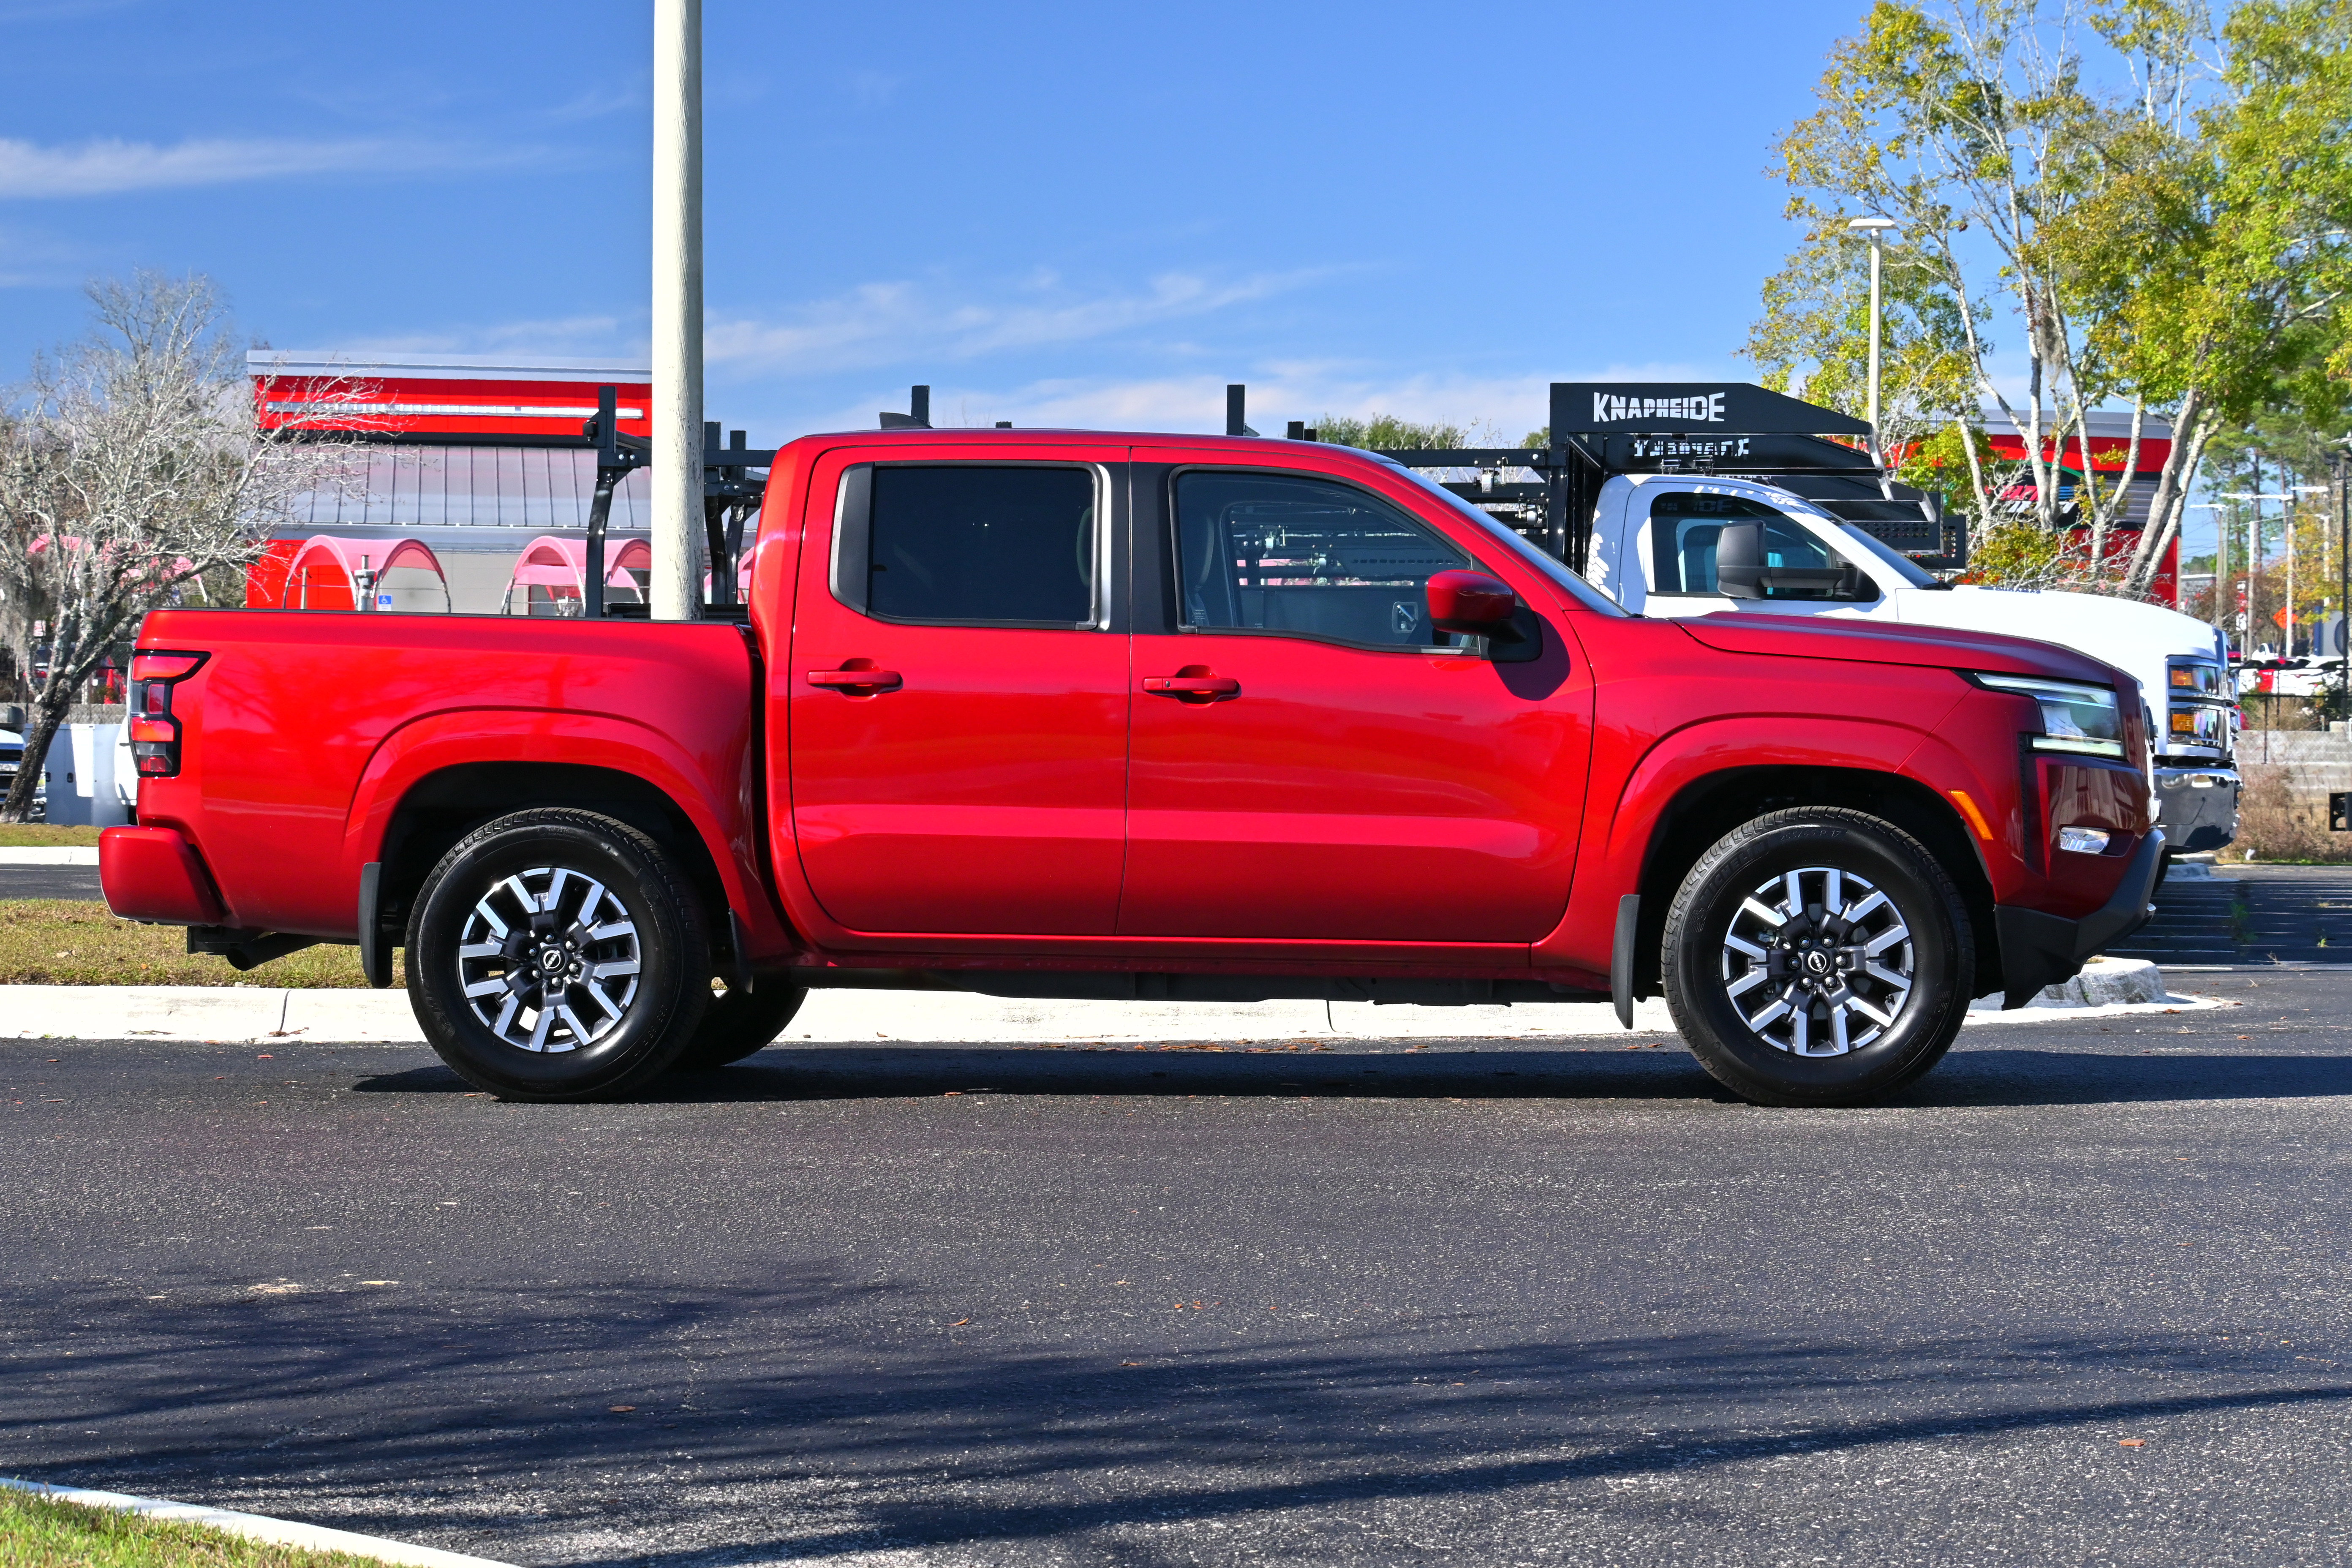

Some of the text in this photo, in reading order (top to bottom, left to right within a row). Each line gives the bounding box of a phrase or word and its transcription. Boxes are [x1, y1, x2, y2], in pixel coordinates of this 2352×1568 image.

[1593, 392, 1725, 422] KNAPHEIDE
[1699, 841, 1766, 904] MICHELIN
[545, 950, 561, 970] NISSAN
